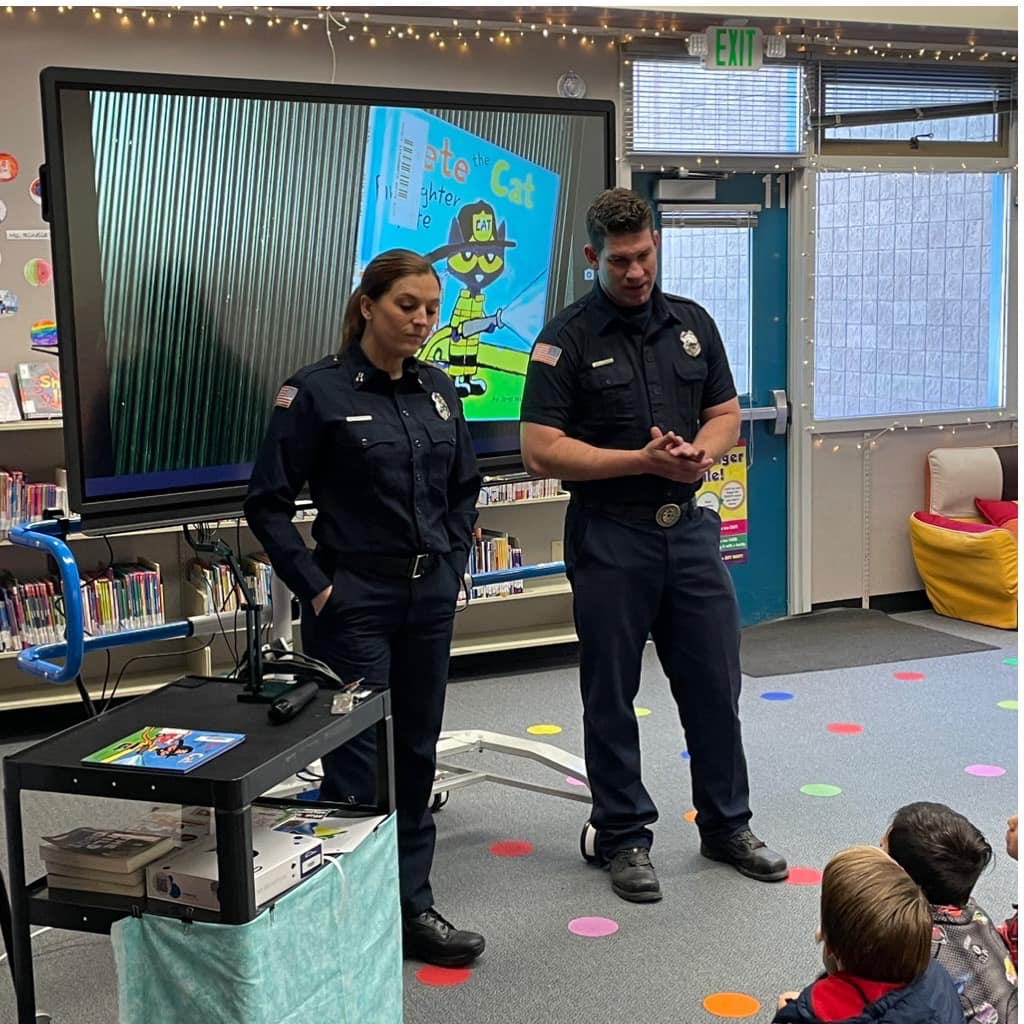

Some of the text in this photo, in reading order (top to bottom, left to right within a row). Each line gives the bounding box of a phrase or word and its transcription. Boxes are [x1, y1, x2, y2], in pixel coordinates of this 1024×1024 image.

[716, 28, 757, 66] EXIT
[424, 138, 535, 210] ete the Cat
[762, 174, 786, 209] 11
[476, 220, 491, 232] CAT
[722, 453, 744, 466] ger
